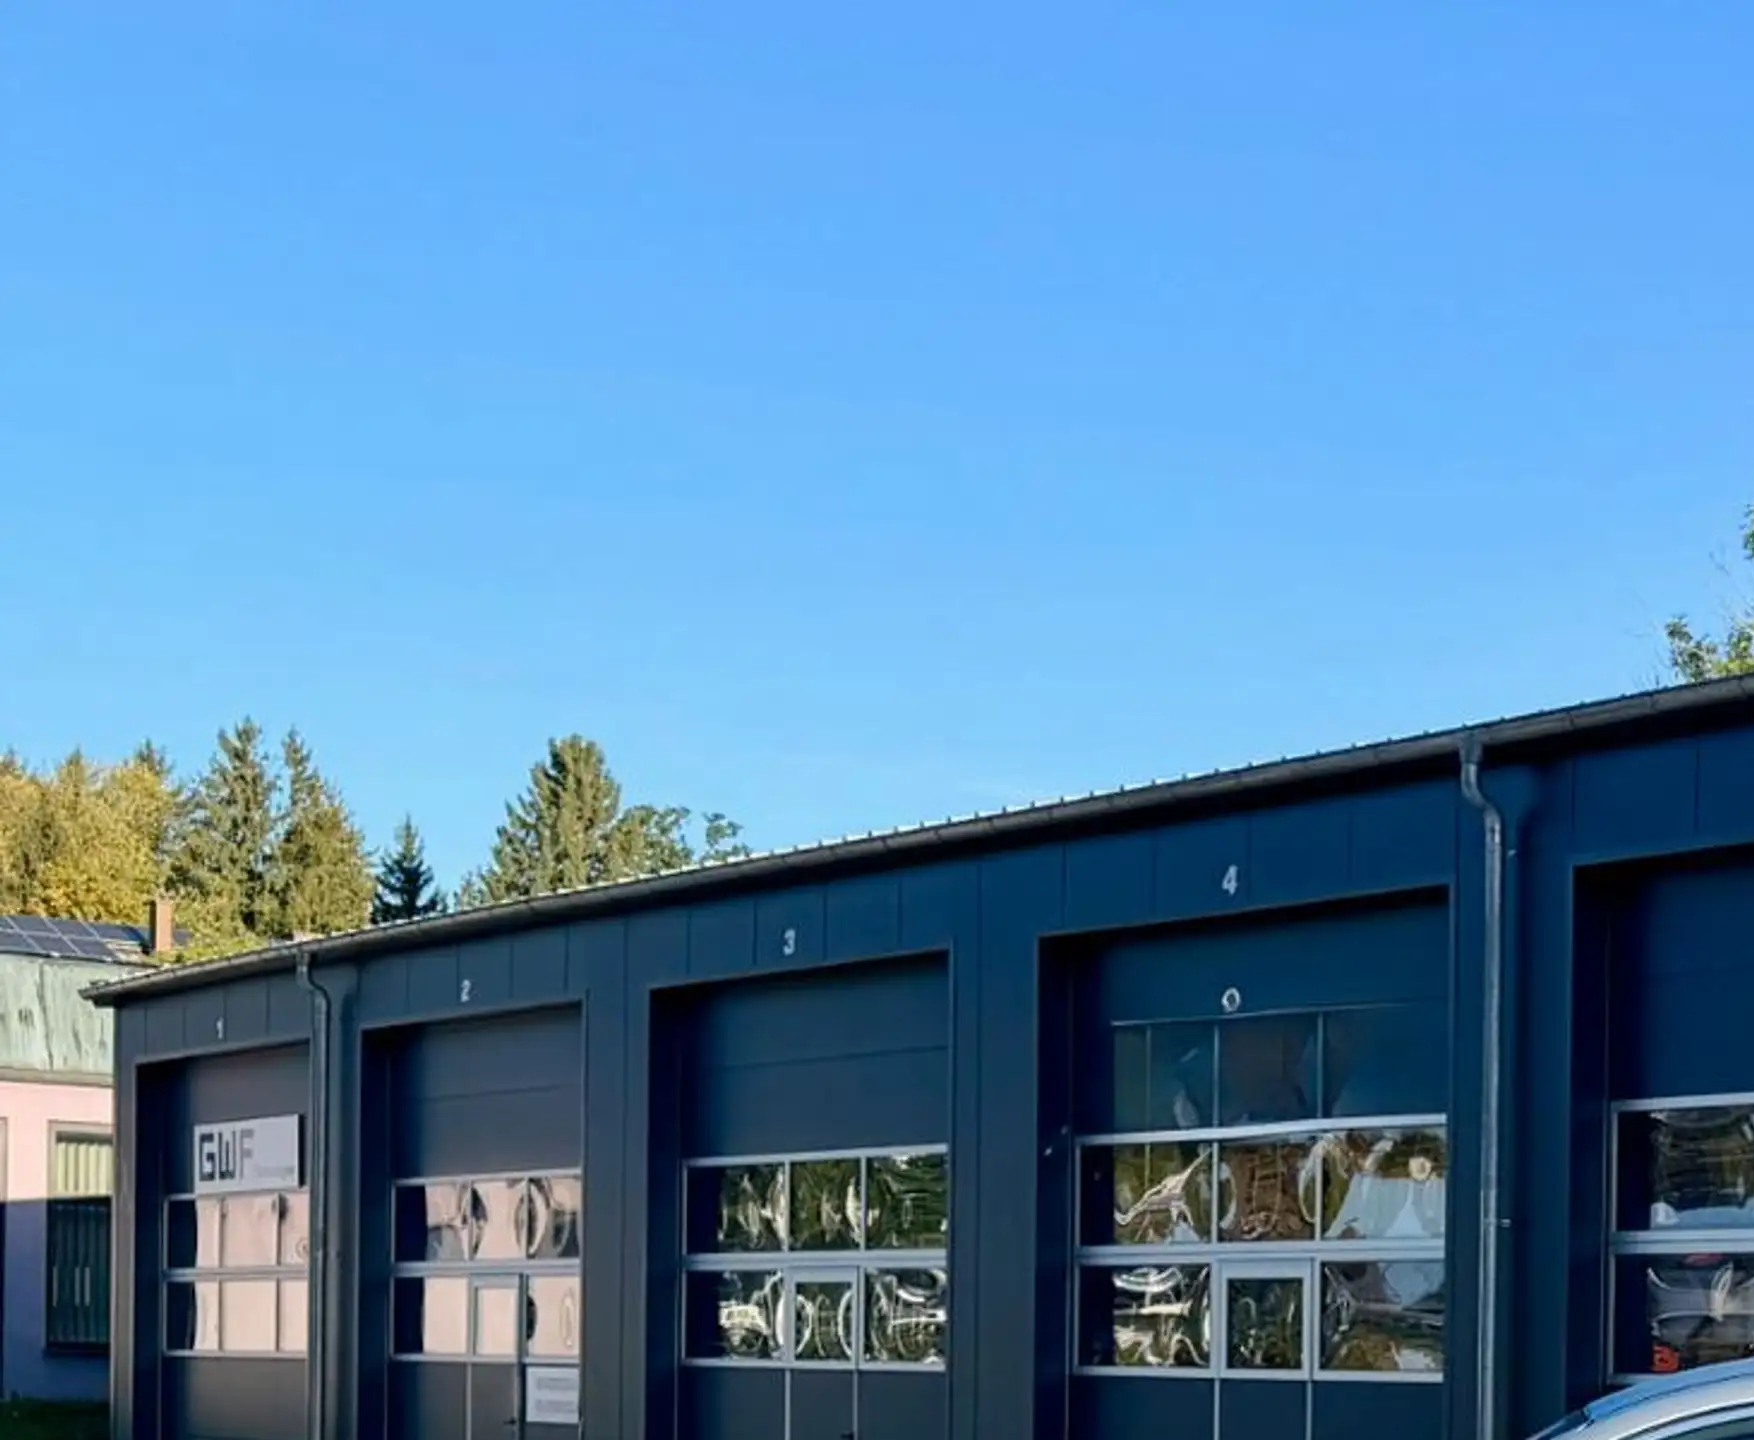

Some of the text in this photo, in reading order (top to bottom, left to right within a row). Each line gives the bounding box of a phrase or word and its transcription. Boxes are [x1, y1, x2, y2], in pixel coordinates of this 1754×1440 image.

[1221, 864, 1238, 896] 4
[783, 929, 796, 956] 3
[460, 979, 472, 1003] 2
[216, 1017, 224, 1039] 1
[199, 1128, 255, 1182] GWF
